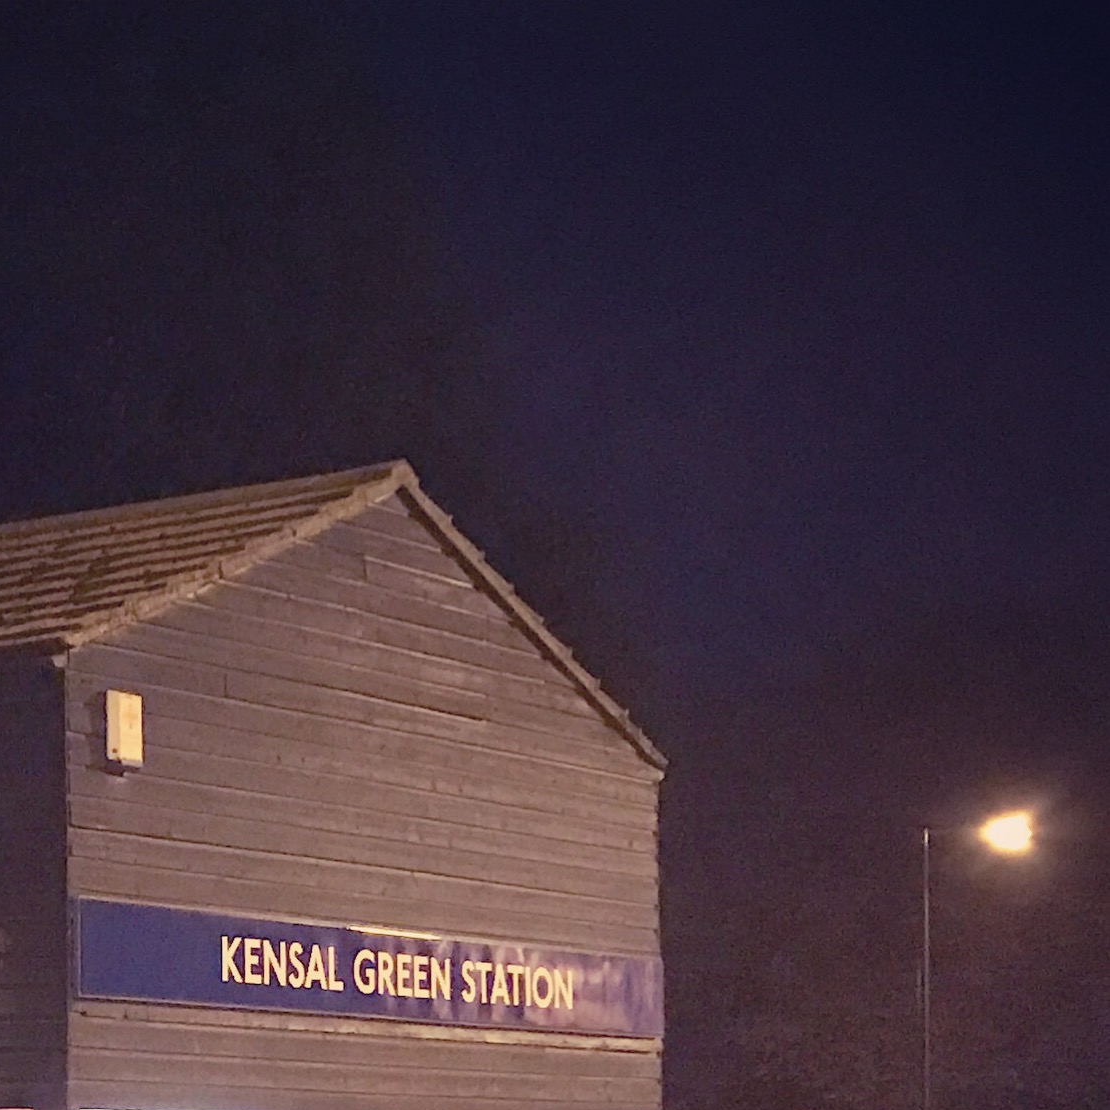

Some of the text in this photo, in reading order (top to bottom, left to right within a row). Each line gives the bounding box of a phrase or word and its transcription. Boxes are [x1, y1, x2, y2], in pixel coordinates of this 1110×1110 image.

[220, 935, 574, 1010] KENSAL GREEN STATION
